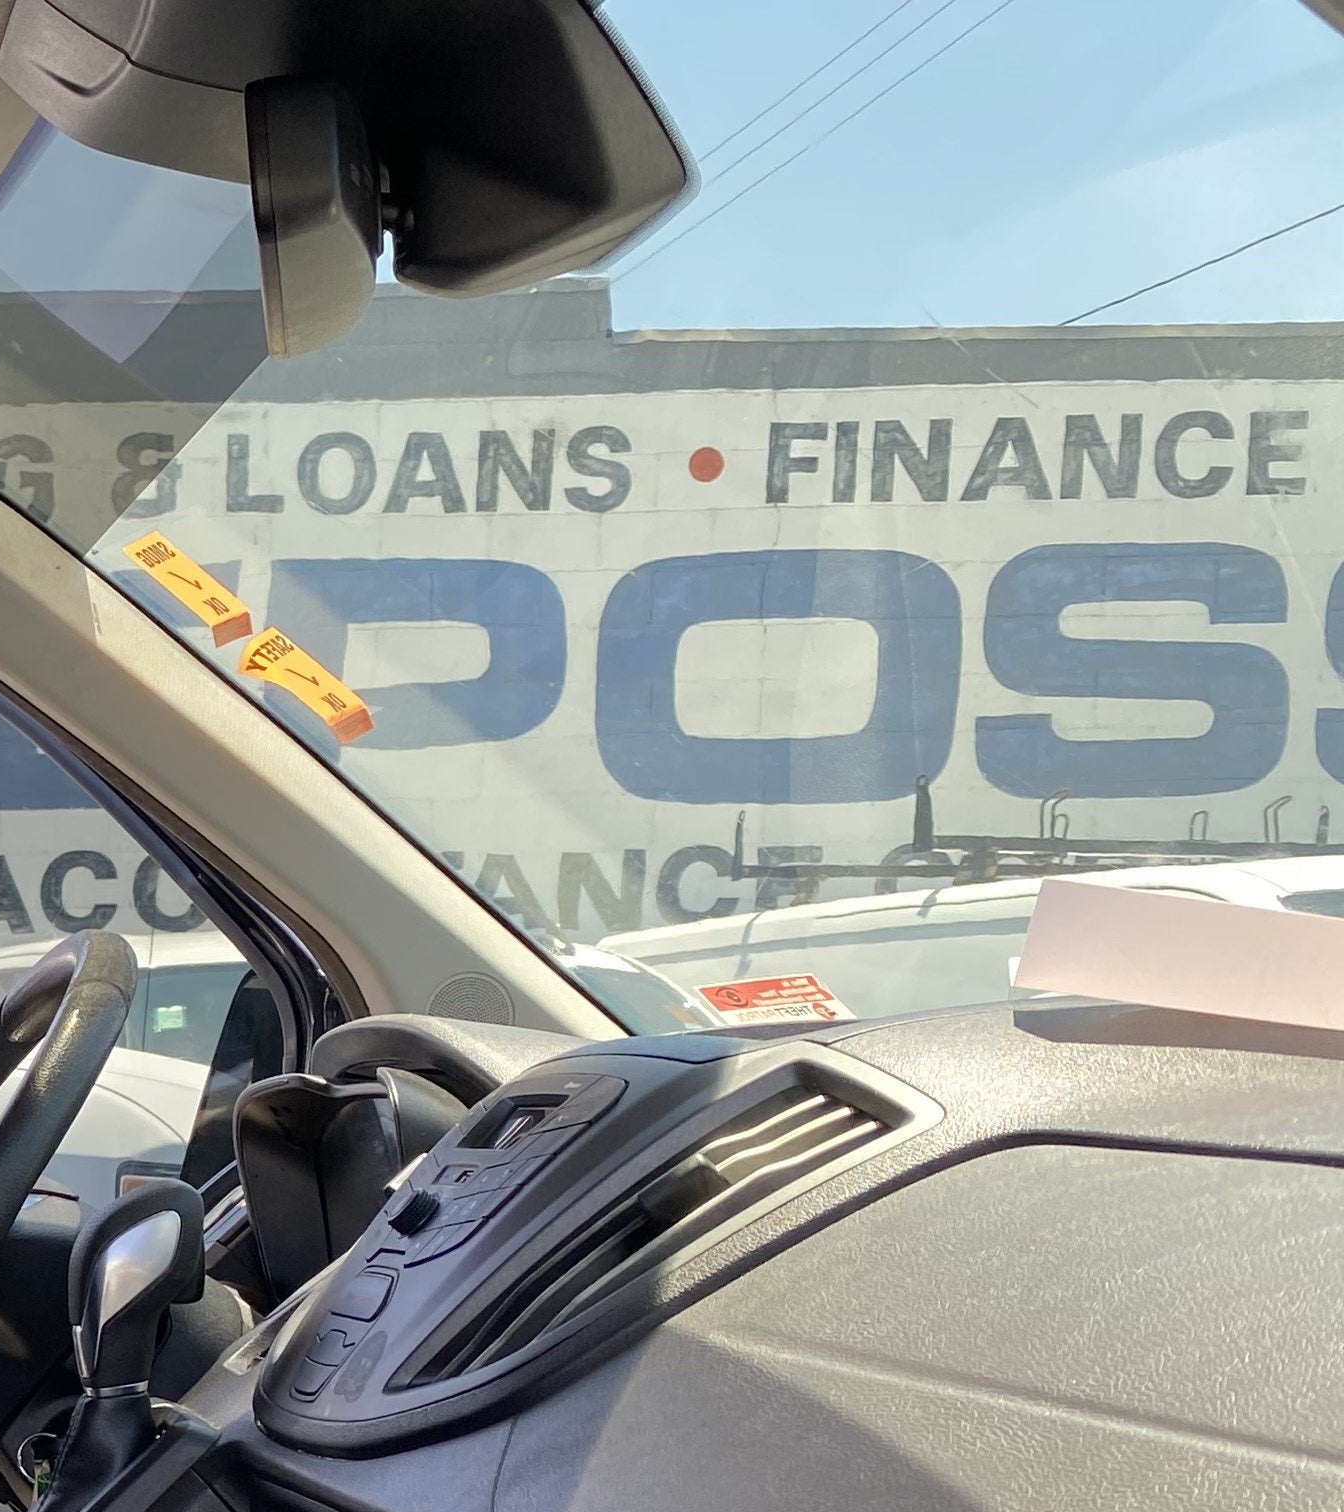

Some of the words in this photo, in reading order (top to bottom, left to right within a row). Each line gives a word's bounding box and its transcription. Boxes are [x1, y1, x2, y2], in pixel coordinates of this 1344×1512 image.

[111, 431, 183, 520] &
[225, 425, 633, 514] LOANS
[766, 409, 1309, 504] FINANCE
